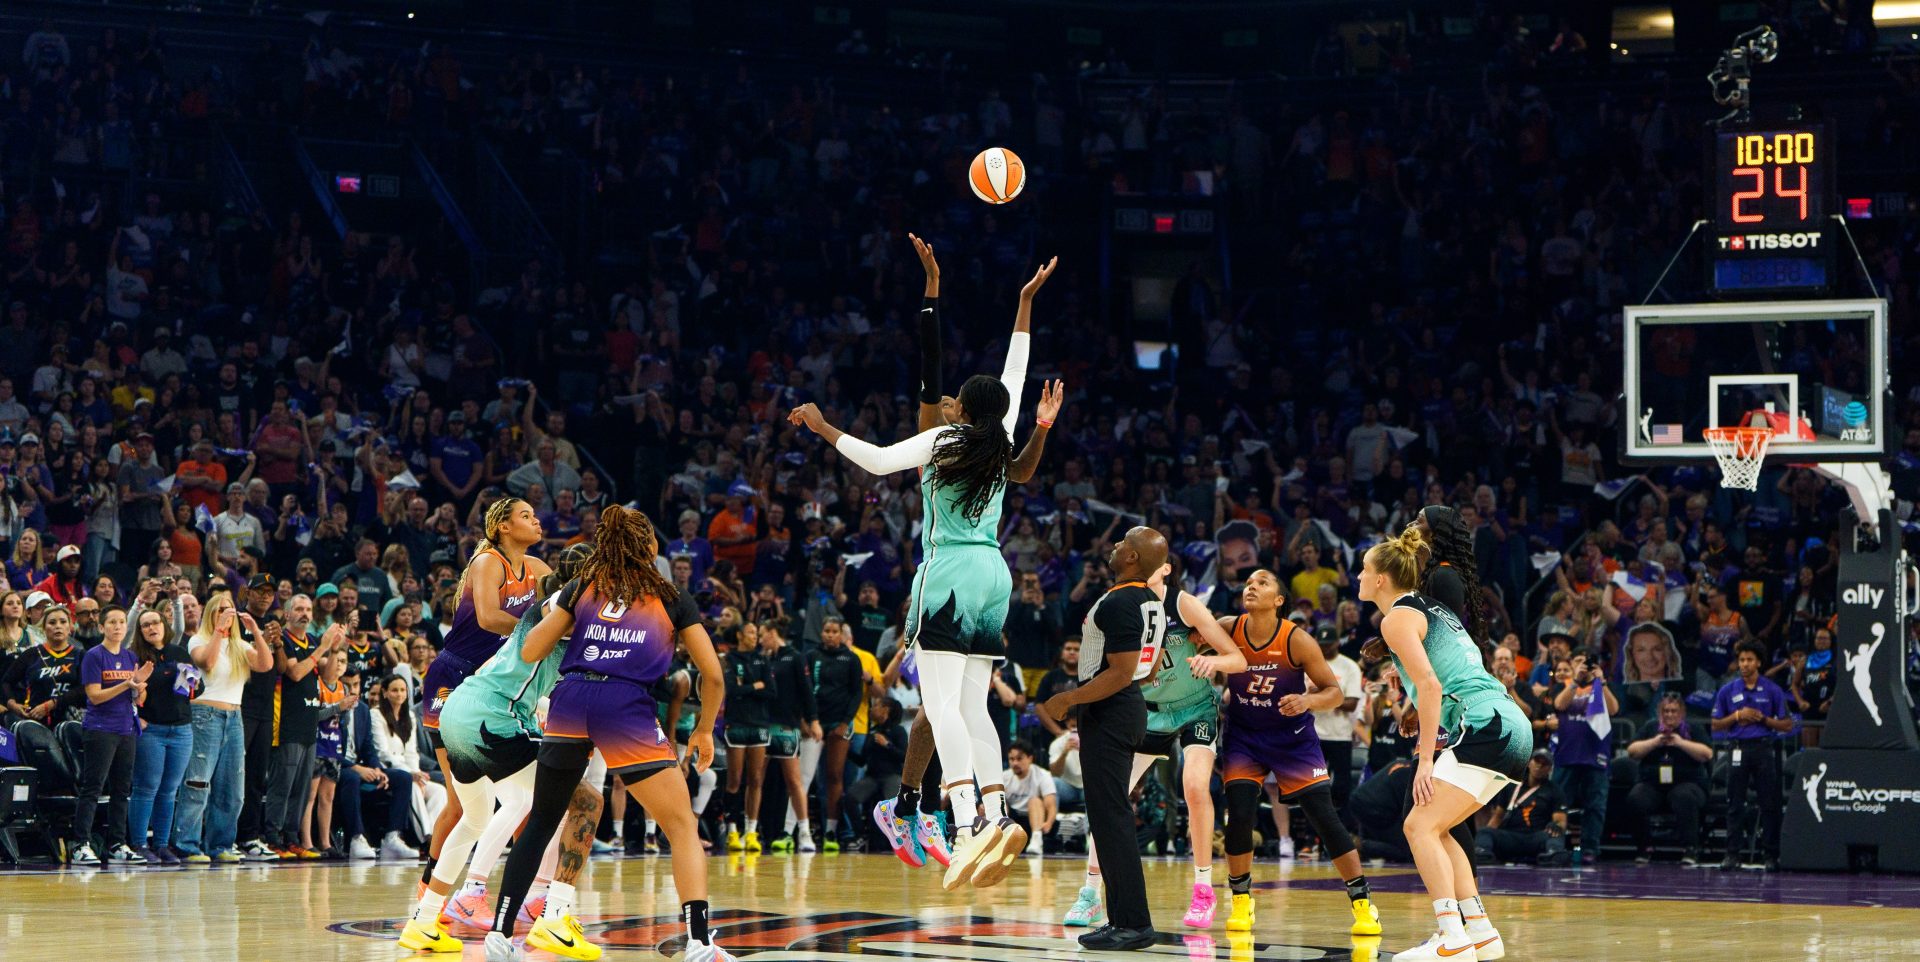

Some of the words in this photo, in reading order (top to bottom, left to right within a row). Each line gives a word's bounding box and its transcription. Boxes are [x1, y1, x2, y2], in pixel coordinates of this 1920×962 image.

[1736, 132, 1815, 166] 10:00
[1732, 165, 1808, 223] 24
[1746, 231, 1821, 251] TISSOT
[1840, 428, 1871, 441] AT&T
[1842, 583, 1884, 610] ally
[1146, 610, 1158, 644] 5
[608, 627, 646, 644] MAKANI
[600, 649, 632, 660] AT&T
[40, 663, 73, 678] PHX
[104, 671, 133, 680] MERCU
[1246, 674, 1278, 695] 25
[1825, 780, 1857, 789] WNBA
[1825, 788, 1920, 804] PLAYOFFS
[1852, 801, 1887, 815] Google
